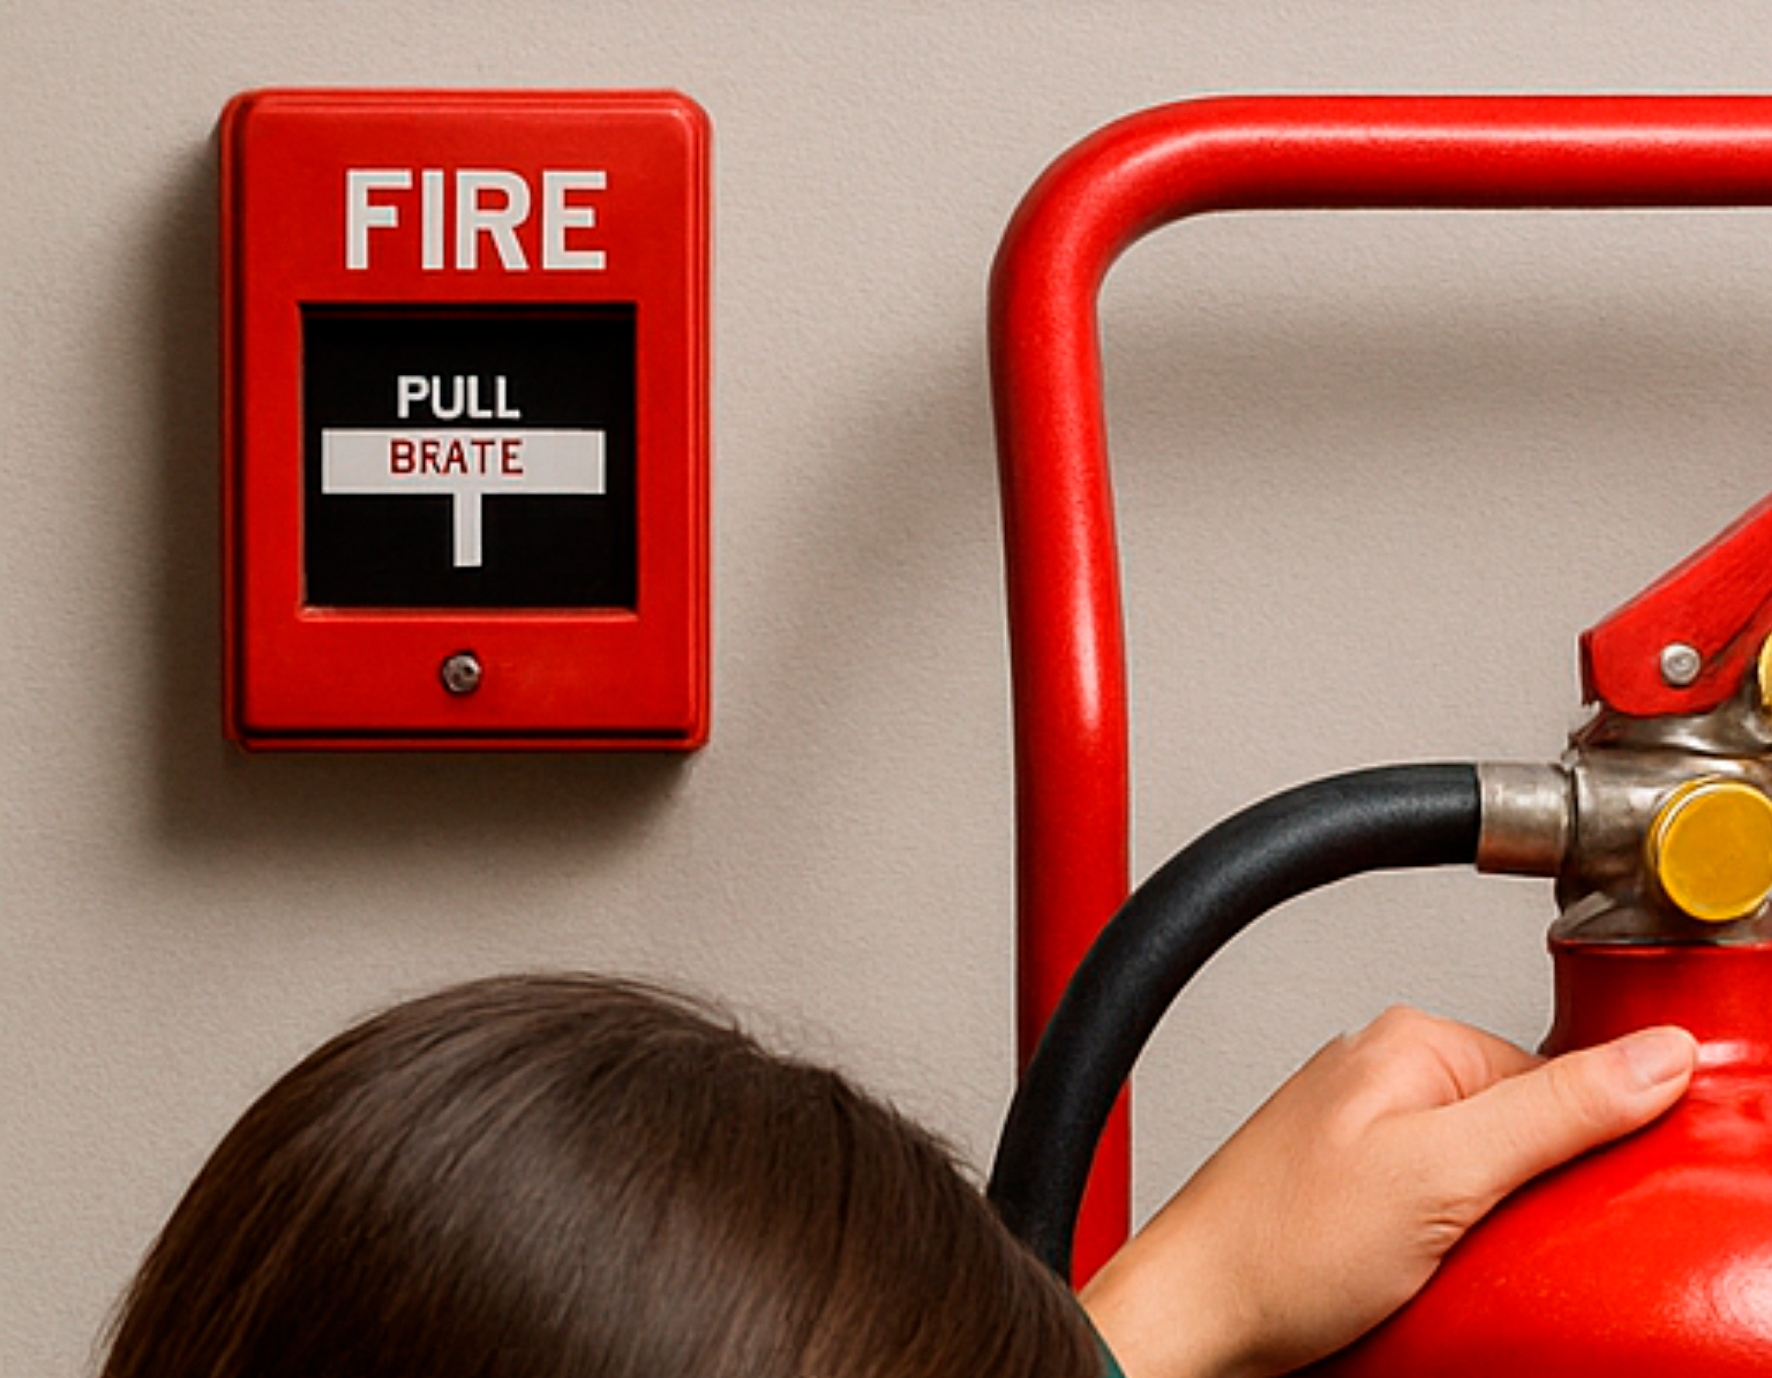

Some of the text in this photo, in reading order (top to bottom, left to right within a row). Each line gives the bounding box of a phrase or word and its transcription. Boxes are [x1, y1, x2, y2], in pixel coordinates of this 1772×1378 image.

[345, 169, 608, 270] FIRE
[398, 375, 521, 419] PULL
[390, 440, 524, 474] BRATE
